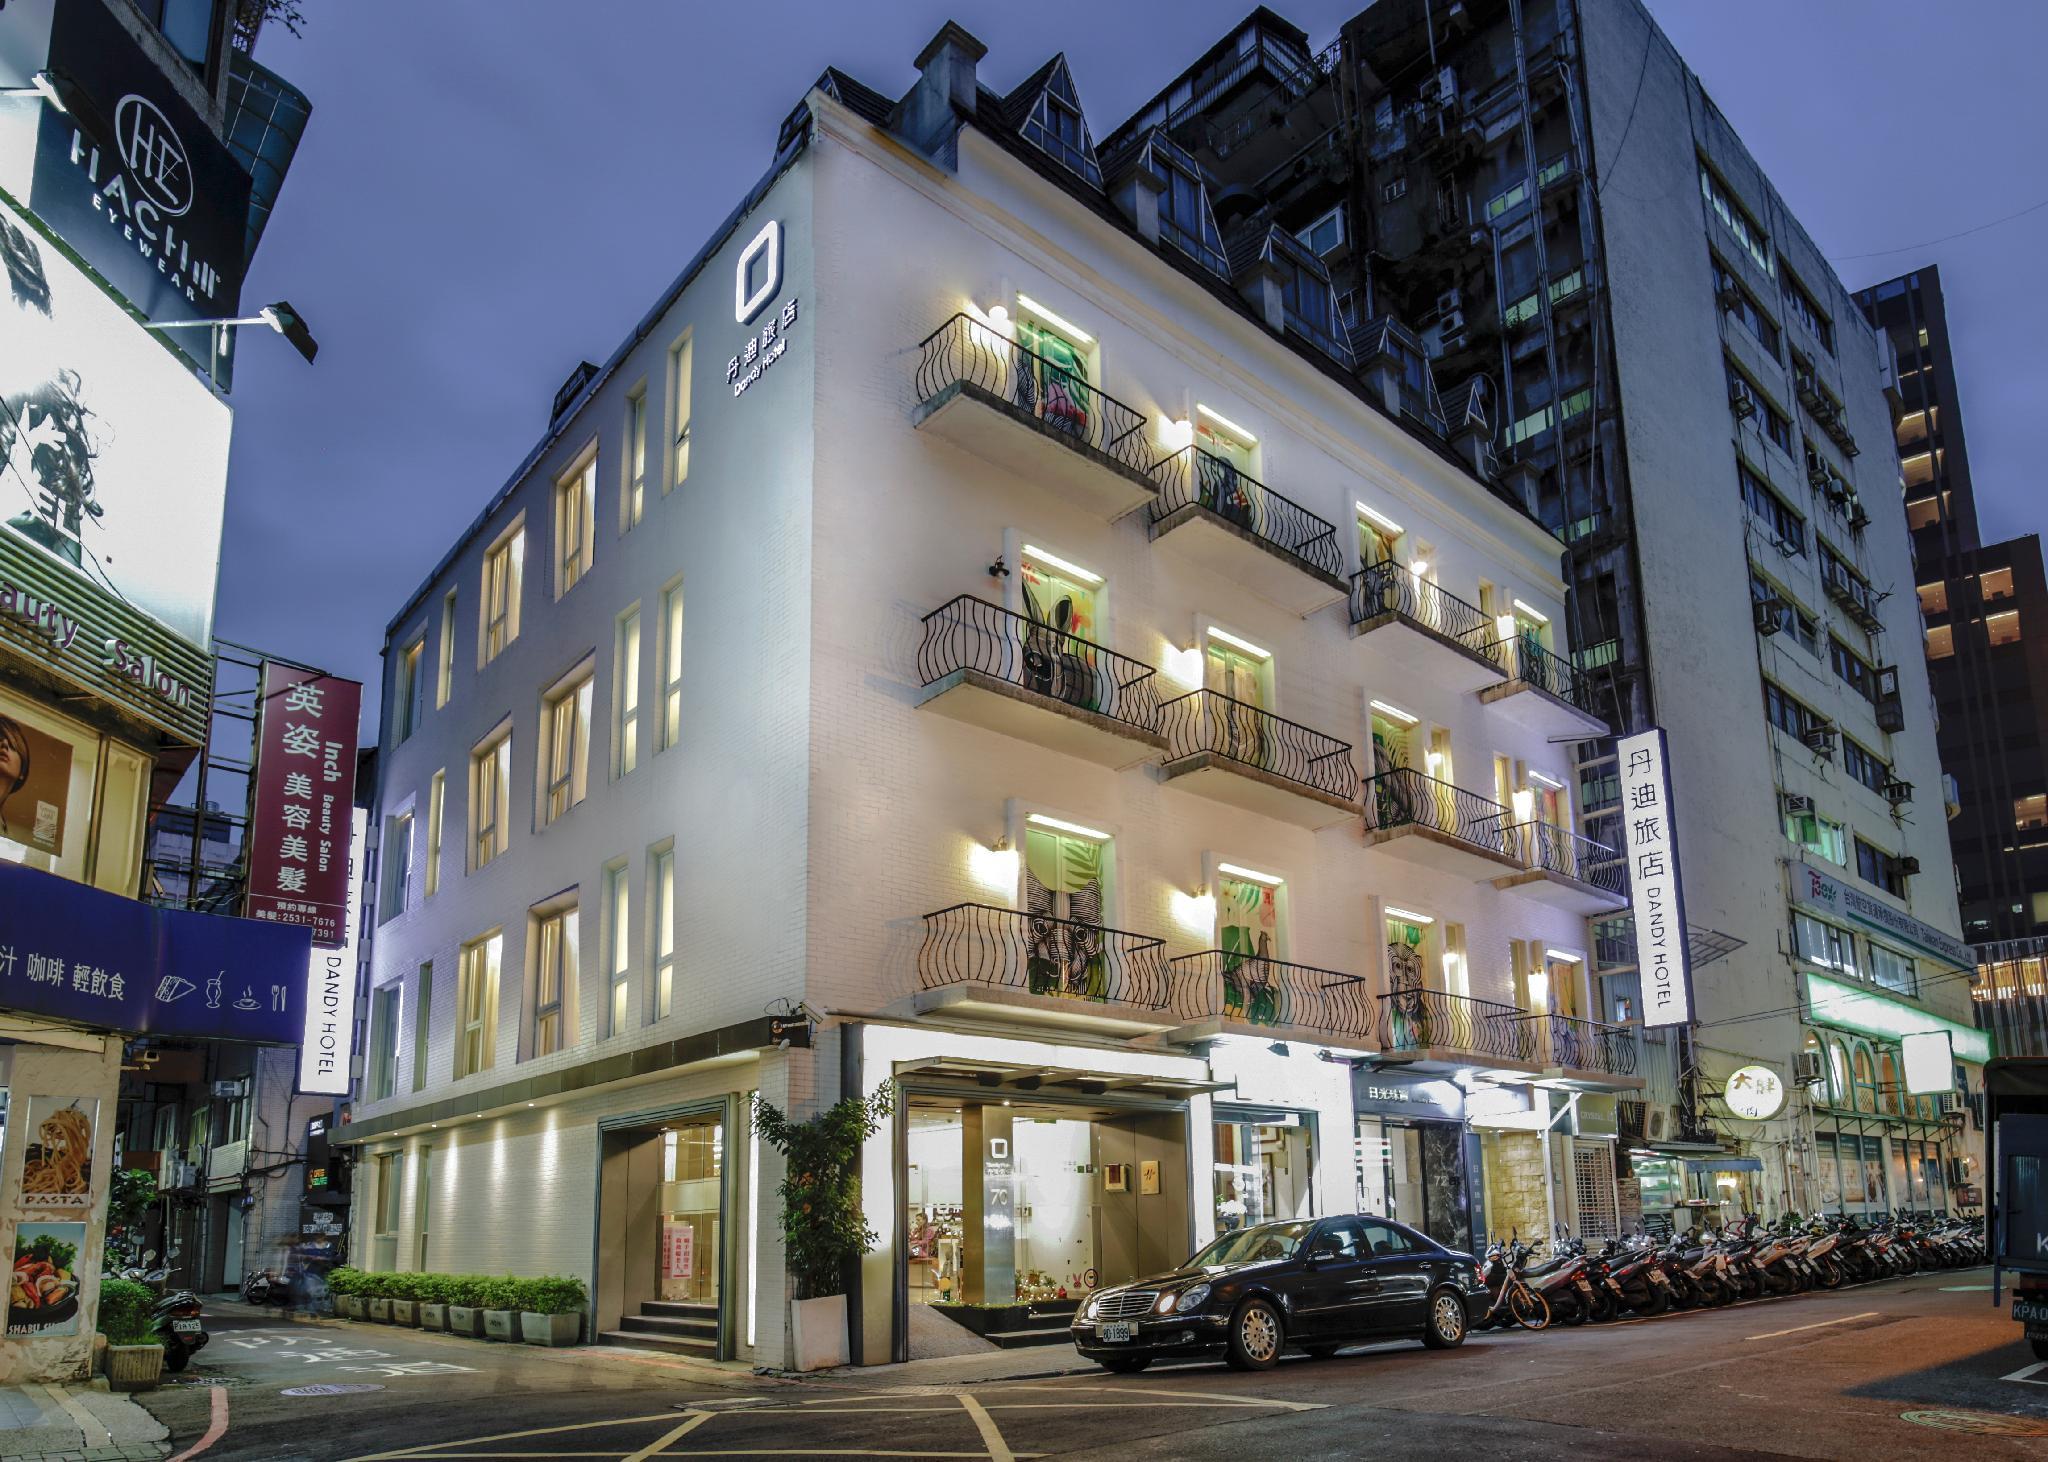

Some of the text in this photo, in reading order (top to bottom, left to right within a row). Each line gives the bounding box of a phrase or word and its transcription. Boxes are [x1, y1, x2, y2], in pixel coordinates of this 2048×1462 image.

[92, 192, 196, 302] EYEWEAR
[762, 338, 787, 370] Hotel
[104, 639, 191, 708] Salon
[318, 740, 344, 873] Inch Beauty Salon
[1627, 748, 1666, 880] 丹迪旅店
[26, 953, 65, 988] 咖啡
[72, 963, 125, 1001] 輕飲食
[1647, 887, 1672, 1009] DANDY HOTEL
[318, 956, 342, 1076] DANDY HOTEL
[24, 1195, 85, 1205] PASTA
[990, 1188, 1008, 1206] 70
